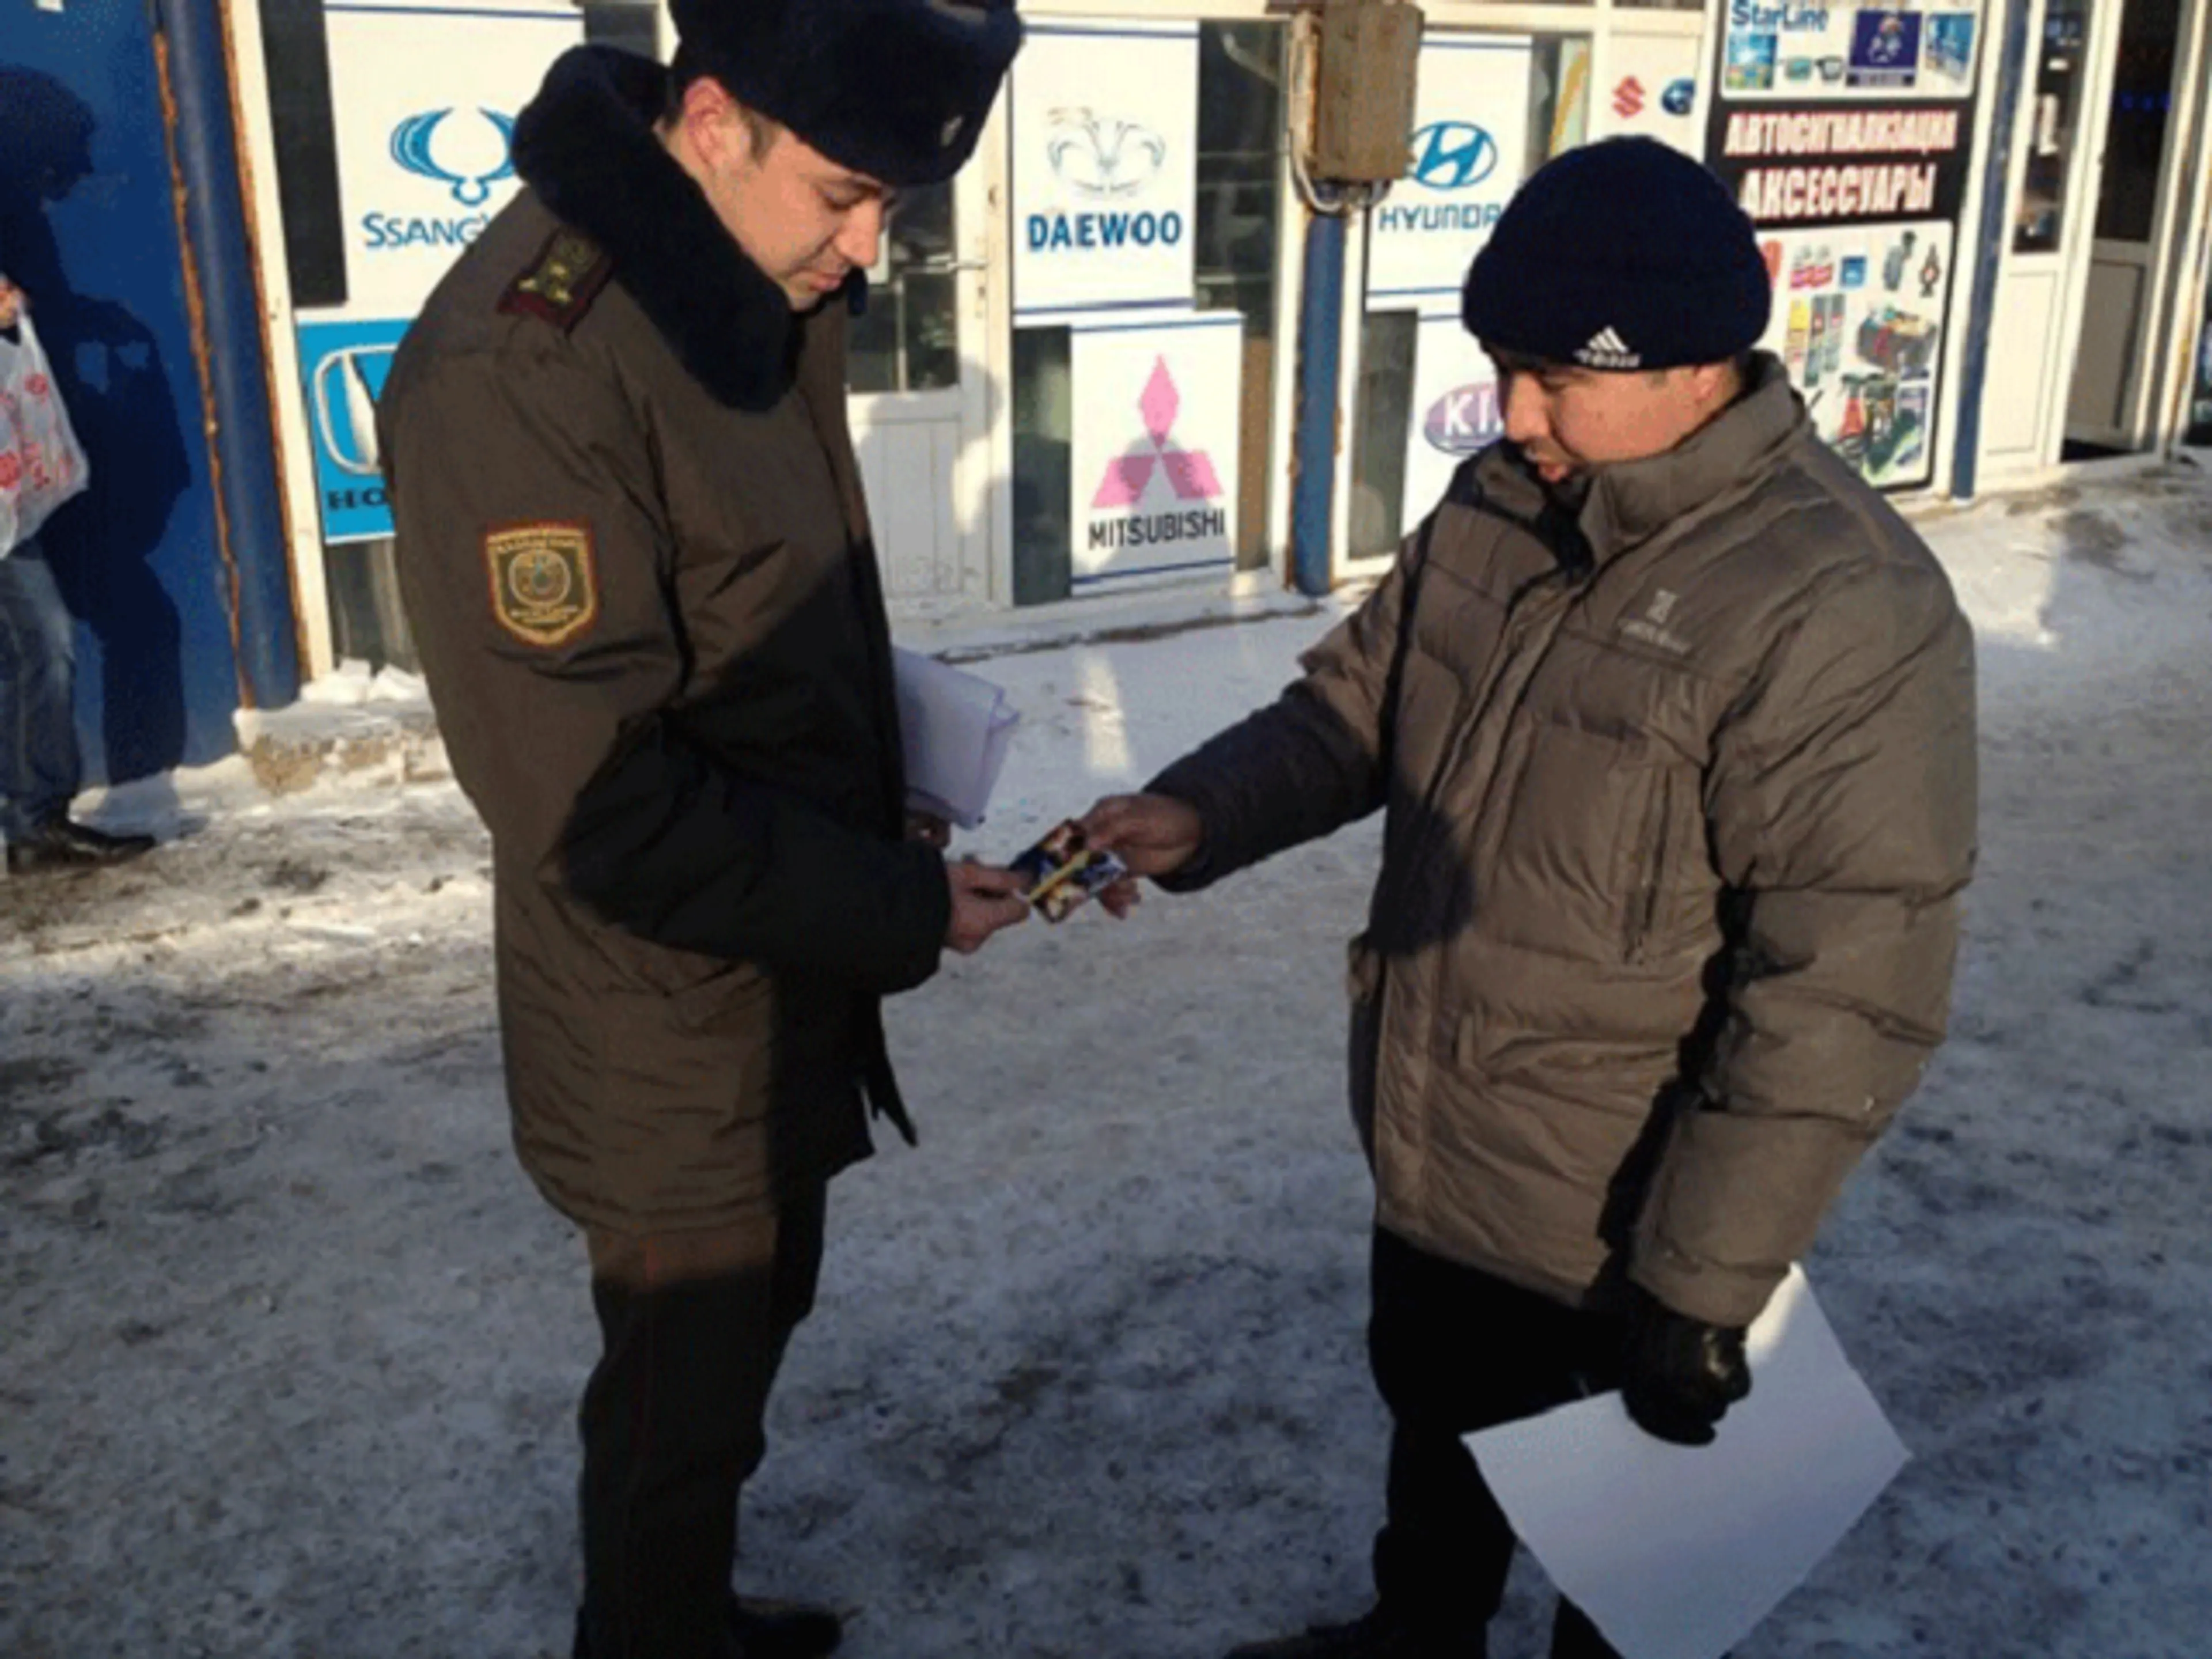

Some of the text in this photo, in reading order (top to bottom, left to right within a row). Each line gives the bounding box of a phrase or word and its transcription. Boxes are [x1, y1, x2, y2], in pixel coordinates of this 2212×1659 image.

[1738, 163, 1937, 219] АКСЕССУАРЫ
[1027, 211, 1181, 250] DAEWOO
[1444, 391, 1505, 436] KI
[1088, 507, 1225, 550] MITSUBISHI
